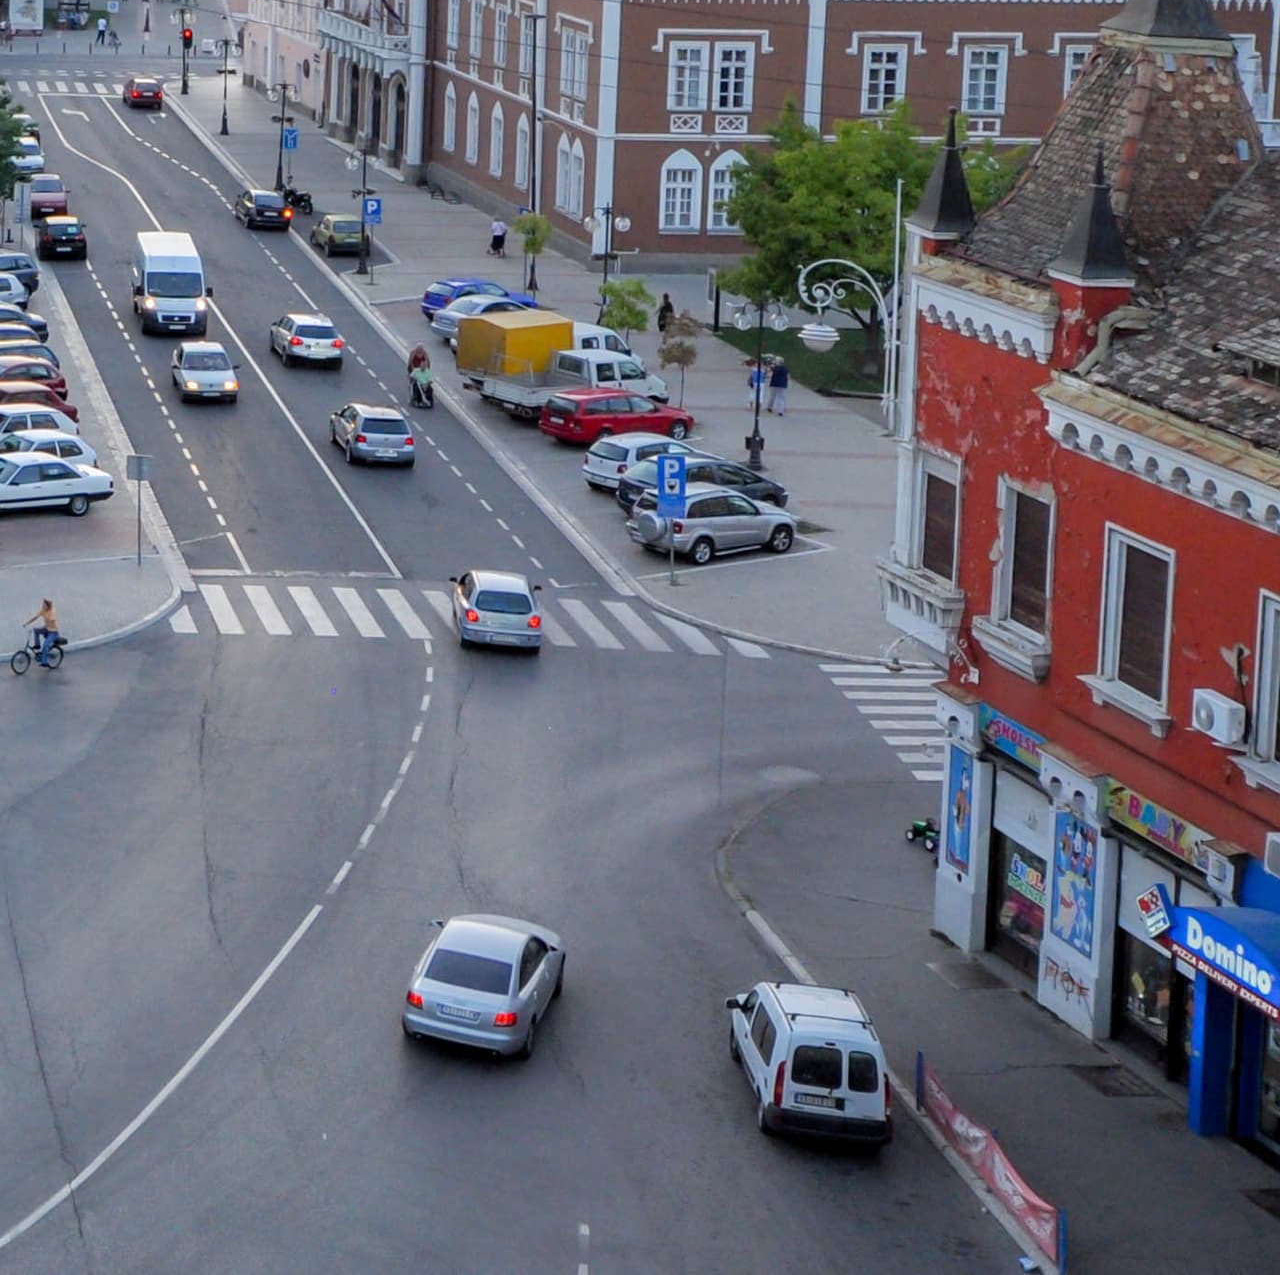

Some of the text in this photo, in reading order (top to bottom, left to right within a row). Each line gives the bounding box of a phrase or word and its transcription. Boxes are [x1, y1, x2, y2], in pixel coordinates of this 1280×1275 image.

[367, 200, 378, 215] P
[664, 459, 680, 478] P
[1128, 794, 1185, 842] BABY
[1187, 915, 1272, 995] Domino
[1171, 943, 1279, 1018] PIZZA DELIVERY EXPERTS
